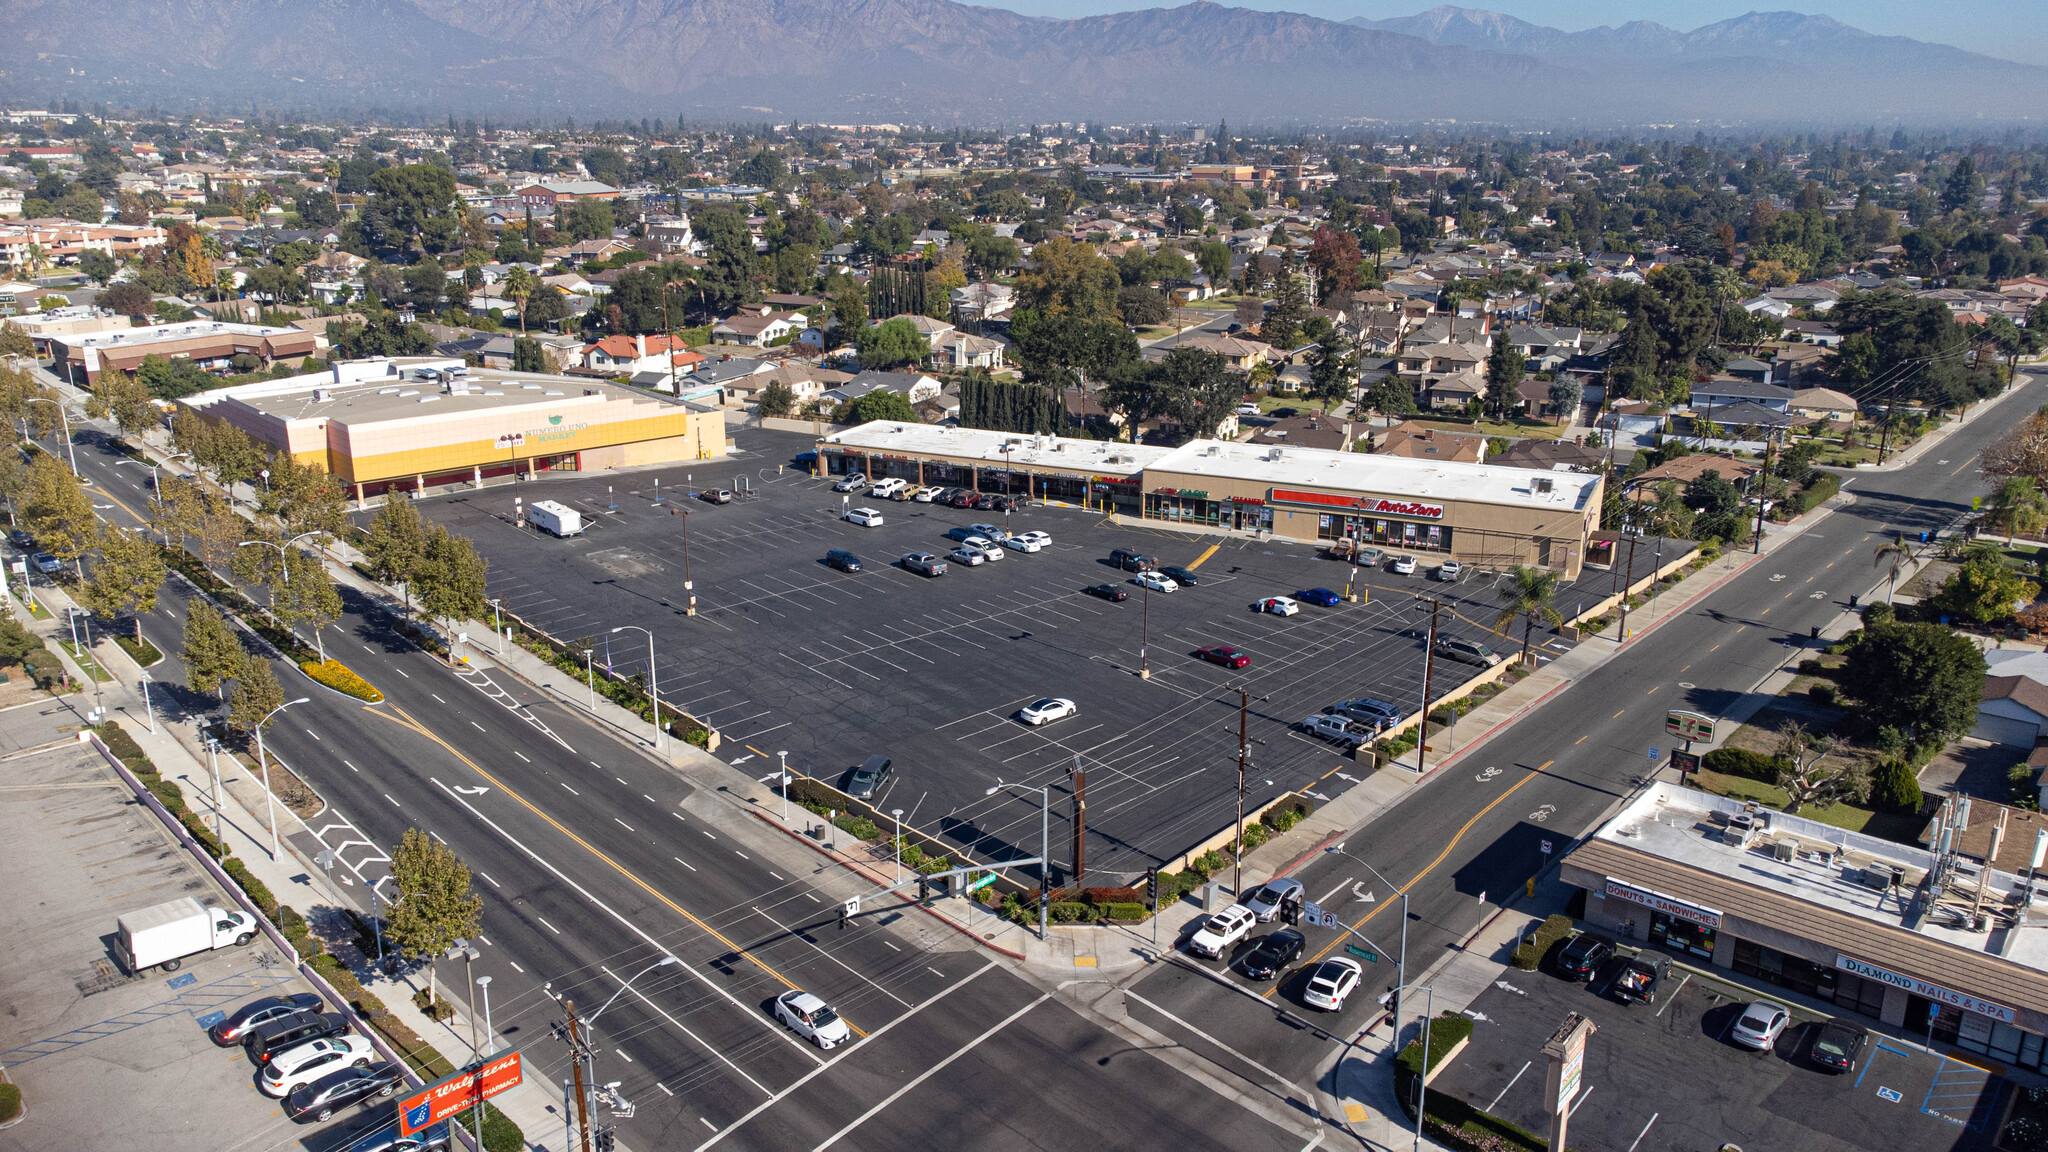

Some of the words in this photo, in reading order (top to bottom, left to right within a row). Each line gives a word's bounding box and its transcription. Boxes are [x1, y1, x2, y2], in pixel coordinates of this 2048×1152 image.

[525, 425, 566, 437] NUMERO
[568, 422, 588, 432] UNO
[538, 431, 576, 442] MARKET
[1232, 496, 1266, 506] CLEANERS
[1375, 500, 1442, 517] AutoZone
[1607, 885, 1645, 904] DONUTS
[1656, 900, 1718, 926] SANDWICHES
[1349, 946, 1372, 960] Rosemead
[1845, 959, 1912, 989] DIAMOND
[1916, 983, 1959, 1005] NAILS
[1963, 998, 1973, 1009] &
[1977, 1003, 2005, 1019] SPA
[435, 1057, 518, 1098] Walgreens
[437, 1094, 480, 1118] DRIVE-THRU
[481, 1076, 519, 1097] PHARMACY
[1928, 1109, 1940, 1117] NO
